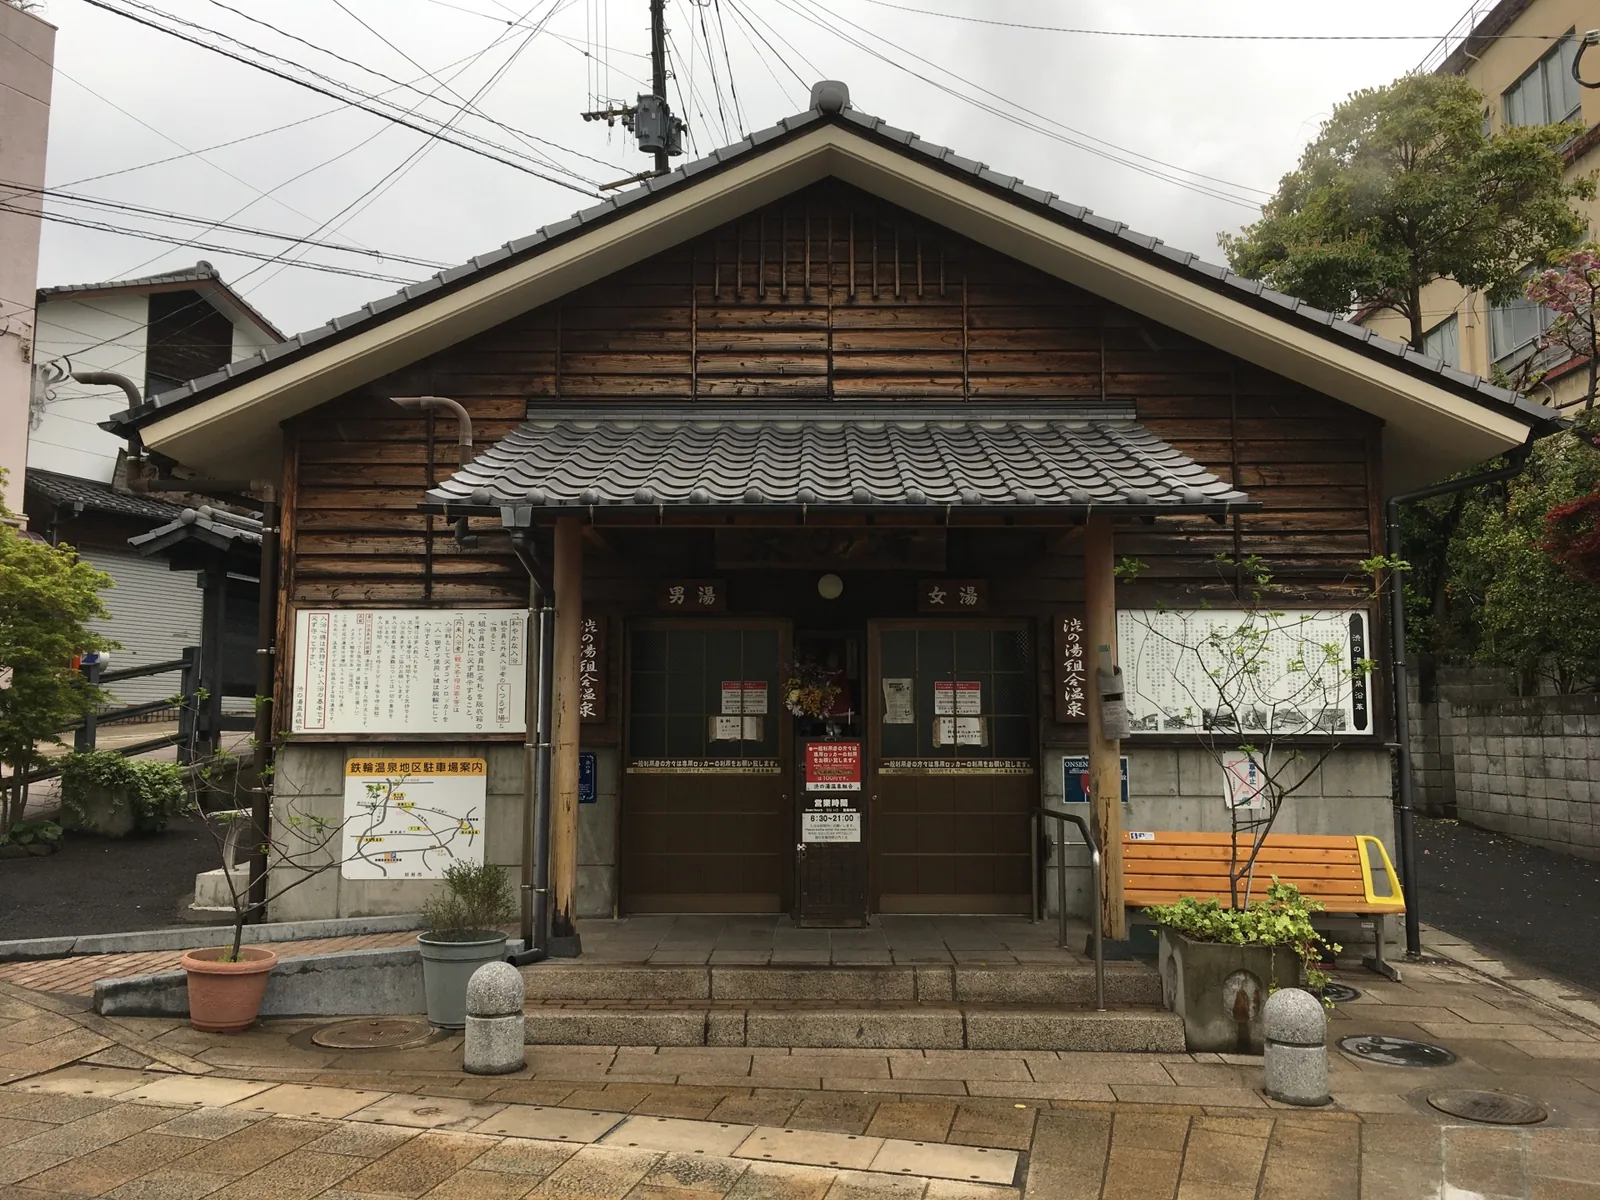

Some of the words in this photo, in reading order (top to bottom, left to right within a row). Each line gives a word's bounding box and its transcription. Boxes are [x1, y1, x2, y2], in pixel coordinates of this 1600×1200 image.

[669, 586, 716, 605] 男湯
[928, 586, 978, 605] 女湯
[1063, 617, 1086, 719] 渋の湯組合温泉
[350, 761, 483, 773] 鉄輪温泉地区駐車場案内
